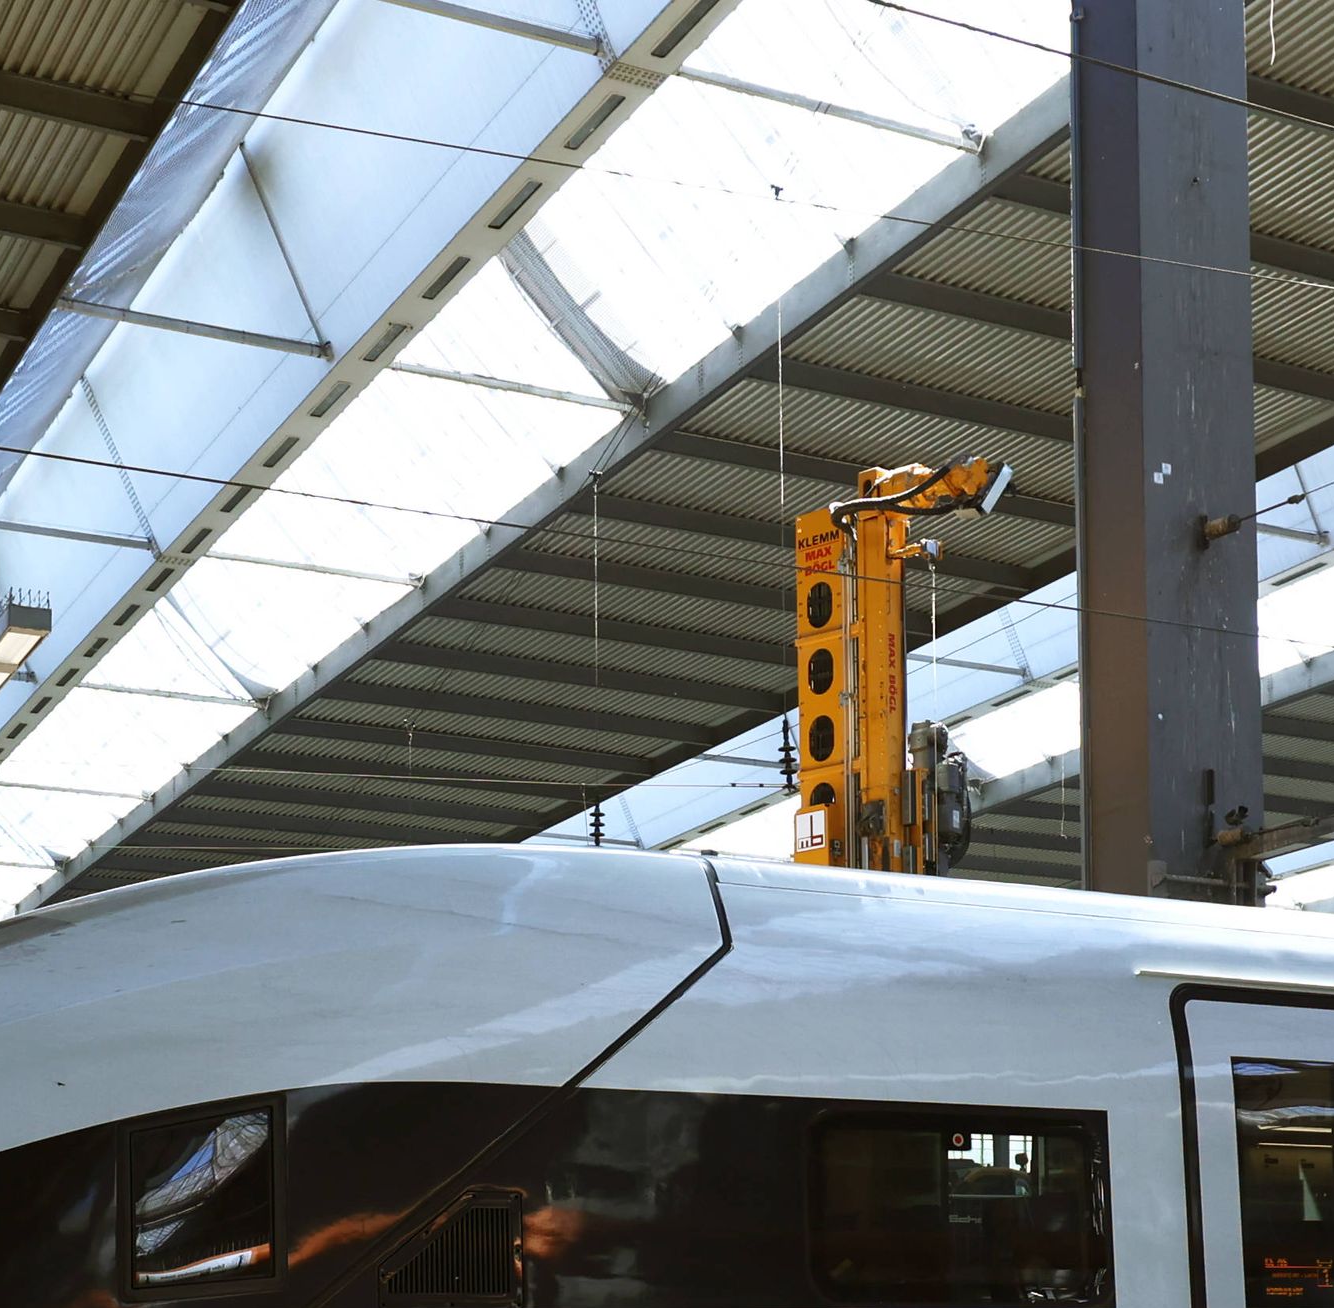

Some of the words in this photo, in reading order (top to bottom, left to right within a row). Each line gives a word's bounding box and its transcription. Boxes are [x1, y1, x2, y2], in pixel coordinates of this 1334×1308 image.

[798, 529, 840, 550] KLEMM
[805, 545, 832, 563] MAX
[804, 558, 836, 577] BÖGL
[888, 632, 896, 669] MAX
[888, 674, 897, 714] BÖGL
